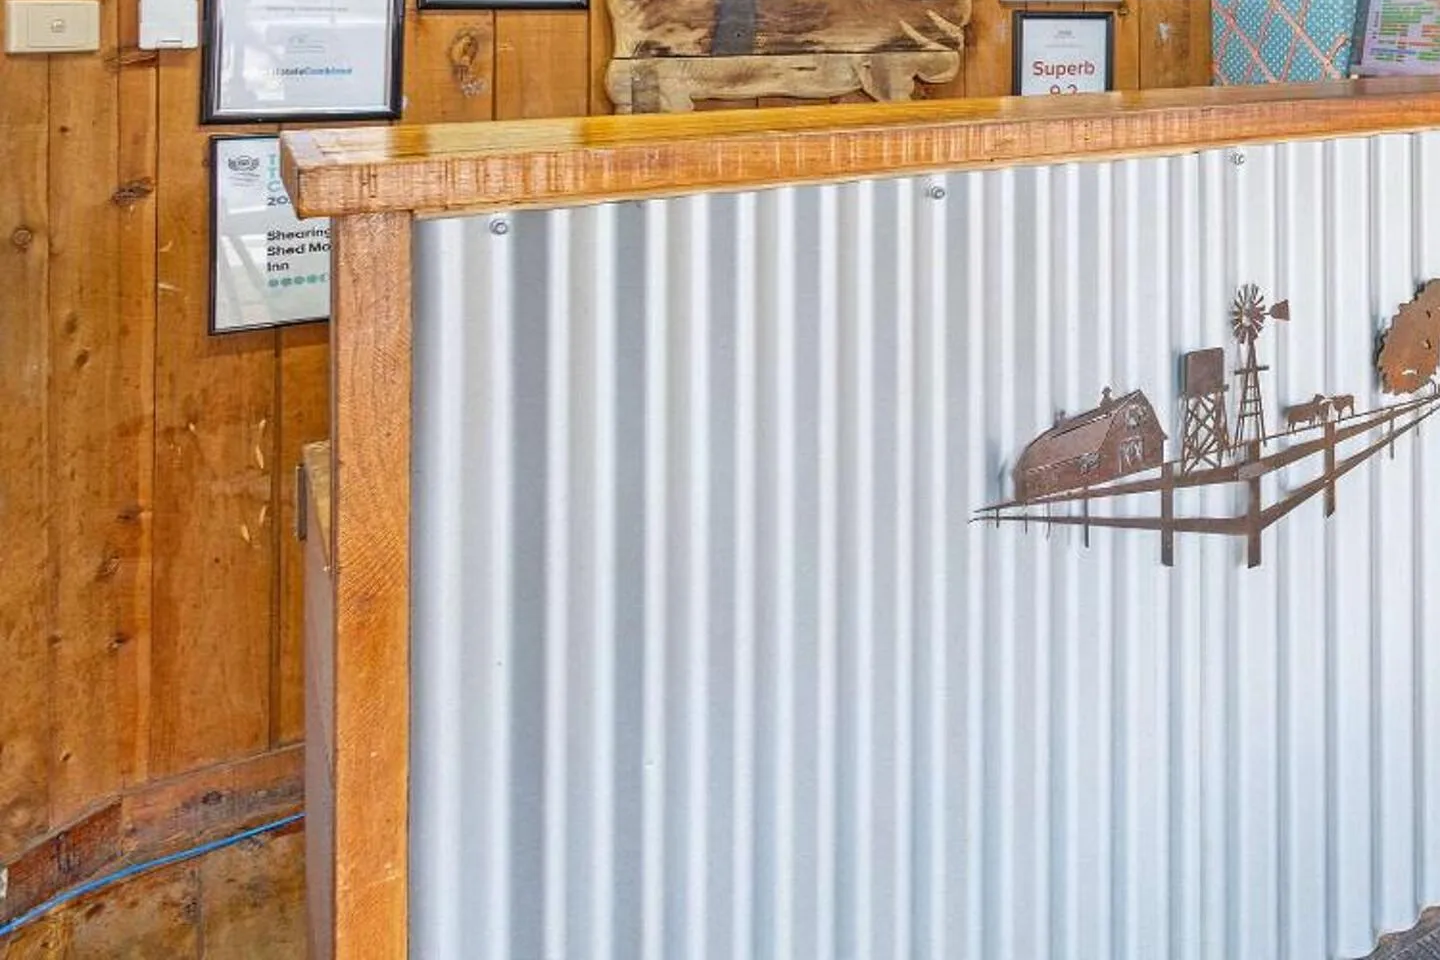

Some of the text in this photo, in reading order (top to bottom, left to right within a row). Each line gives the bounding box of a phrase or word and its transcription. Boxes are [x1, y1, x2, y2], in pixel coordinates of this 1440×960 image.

[1032, 60, 1096, 80] Superb
[267, 195, 291, 207] 20
[267, 242, 305, 257] Shed
[267, 261, 290, 273] Inn
